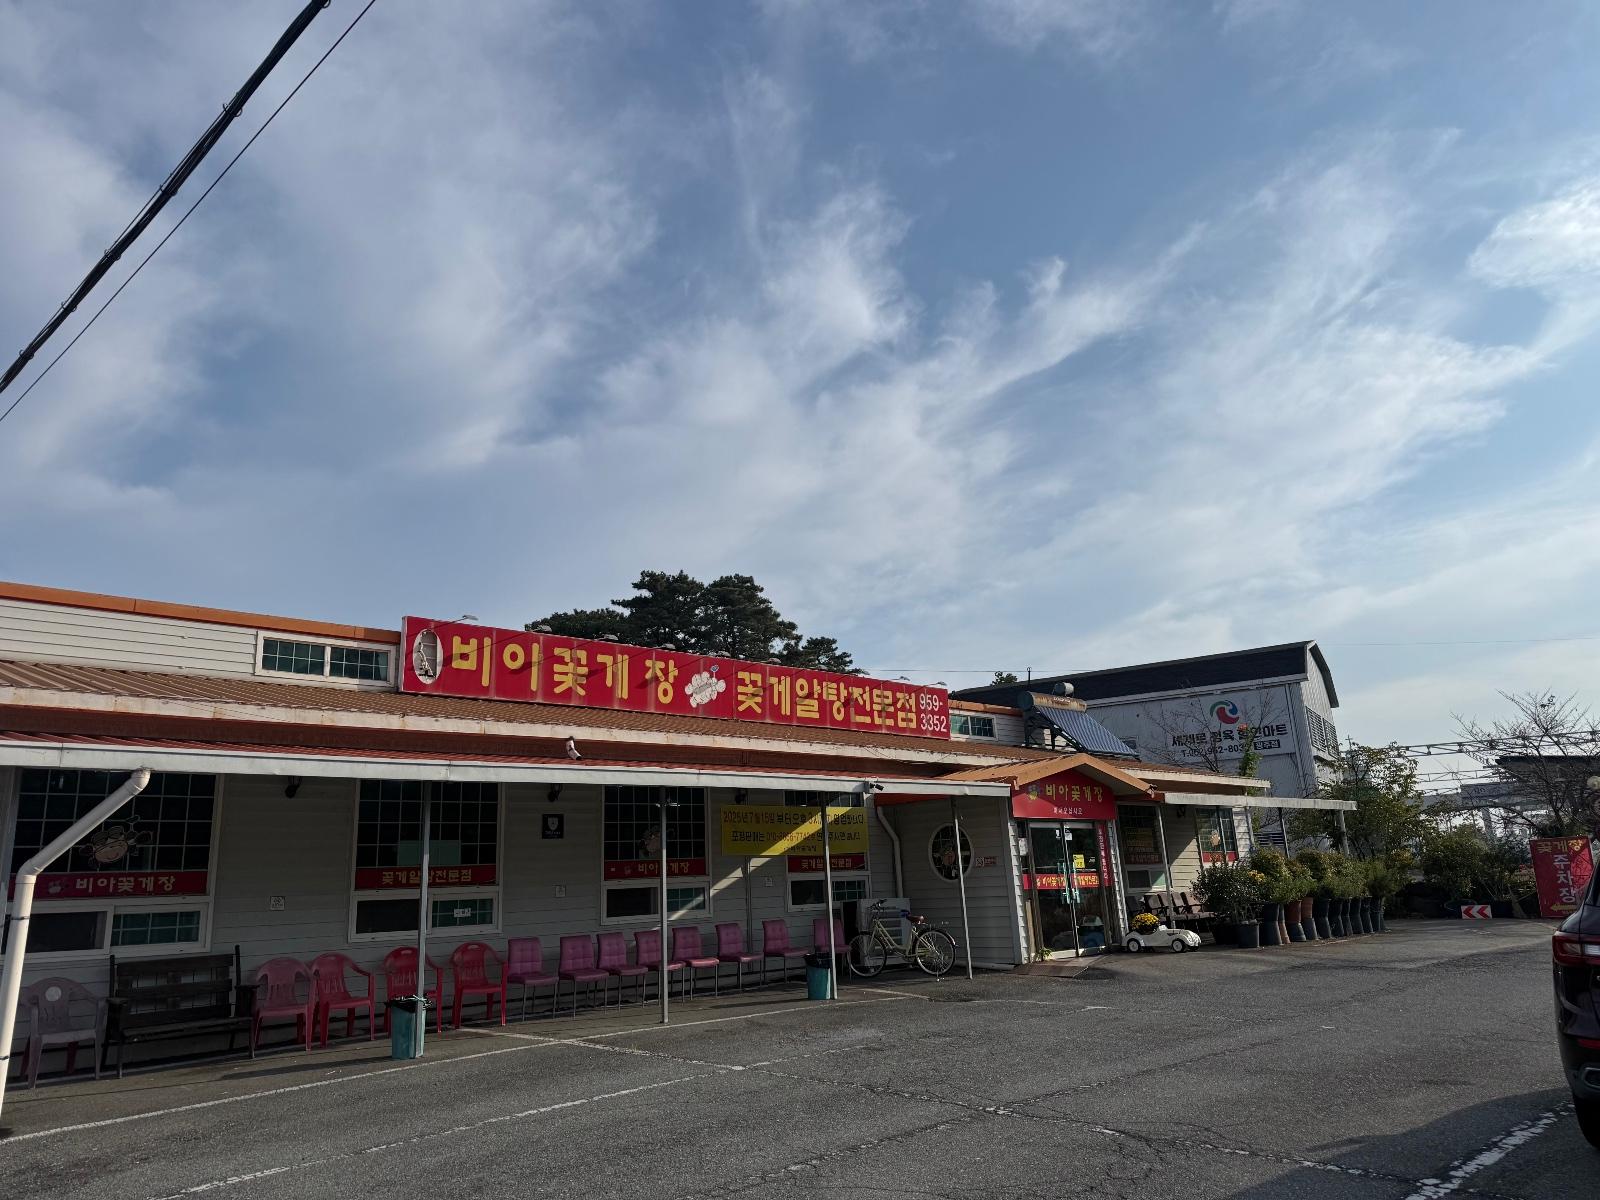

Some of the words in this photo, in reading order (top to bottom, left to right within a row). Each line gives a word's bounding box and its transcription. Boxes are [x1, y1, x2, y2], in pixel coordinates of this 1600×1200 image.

[919, 693, 943, 711] 959-
[920, 713, 947, 732] 3352
[1045, 784, 1103, 803] 비아꽃게장
[1537, 839, 1583, 852] 꽃게장
[638, 862, 689, 875] 비아게장
[75, 876, 176, 893] 비아꽃게장
[1553, 854, 1577, 903] 주차장
